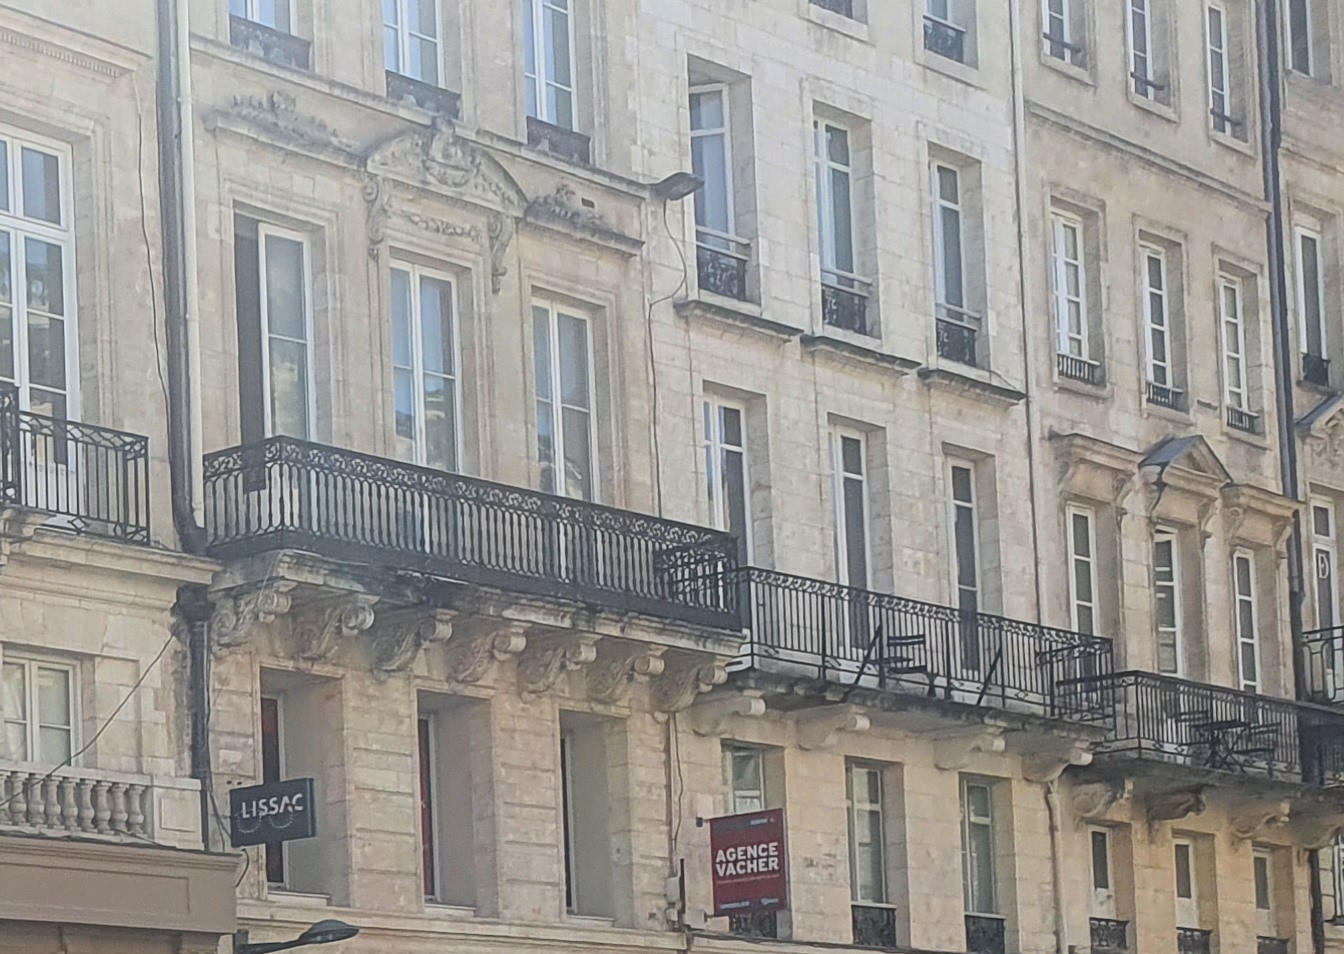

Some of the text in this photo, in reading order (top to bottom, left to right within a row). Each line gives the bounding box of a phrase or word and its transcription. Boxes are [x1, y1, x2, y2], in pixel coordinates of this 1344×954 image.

[241, 793, 304, 819] LISSAC
[715, 842, 779, 863] AGENCE
[715, 857, 780, 877] VACHER
